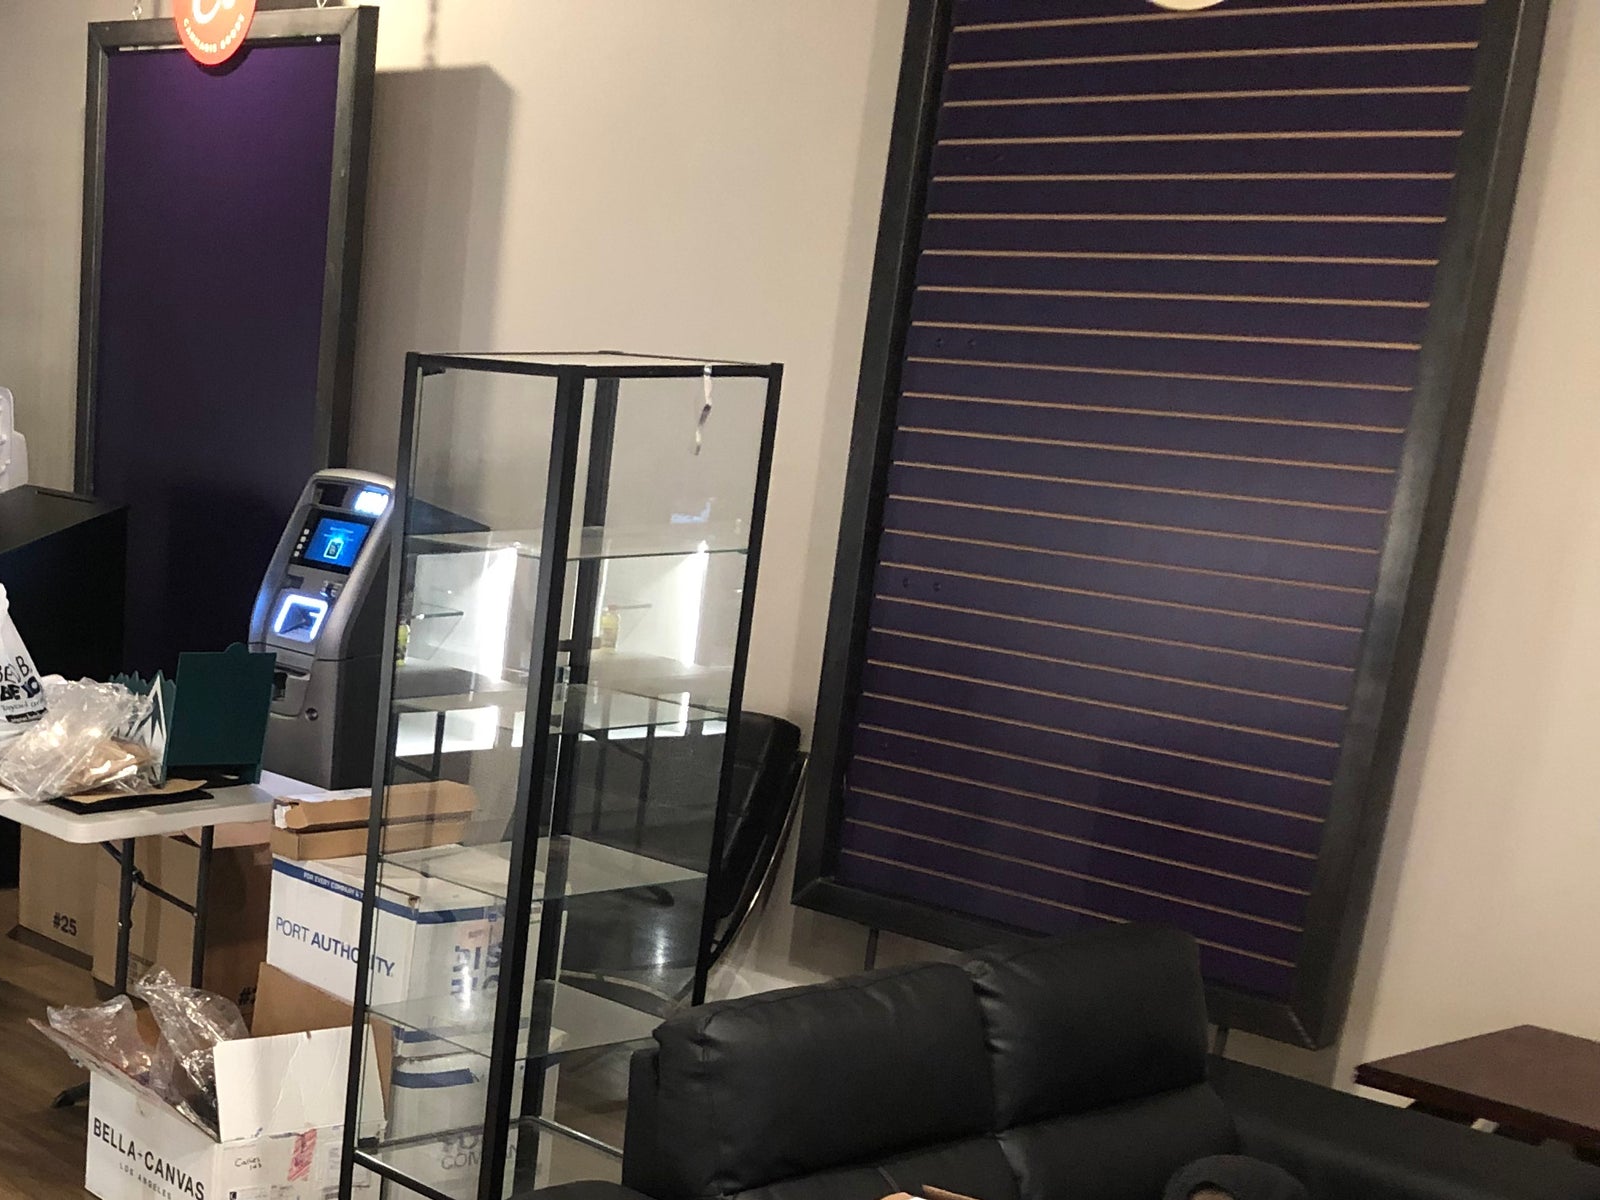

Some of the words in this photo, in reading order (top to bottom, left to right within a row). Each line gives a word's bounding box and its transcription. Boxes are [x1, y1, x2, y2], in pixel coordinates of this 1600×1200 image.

[53, 911, 78, 937] #25
[276, 916, 310, 943] PORT
[311, 932, 395, 977] AUTHOITY
